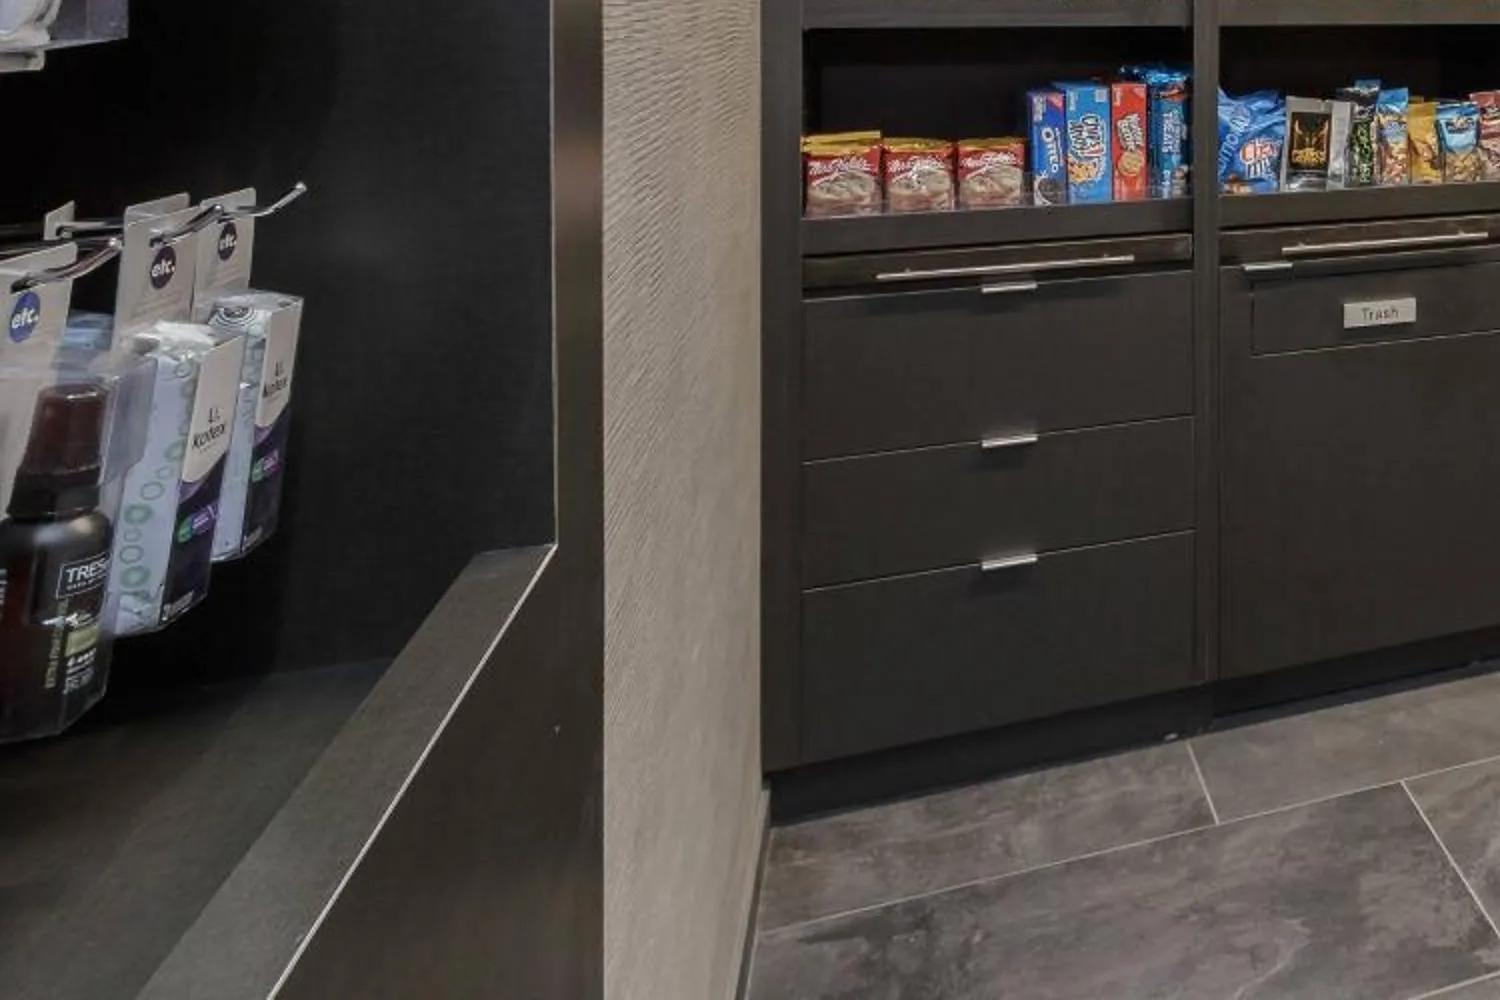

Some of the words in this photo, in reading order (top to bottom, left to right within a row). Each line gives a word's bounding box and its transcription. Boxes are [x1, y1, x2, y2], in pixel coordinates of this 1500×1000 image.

[151, 257, 177, 279] etc.
[11, 306, 40, 330] etc.
[1362, 307, 1399, 321] Trash
